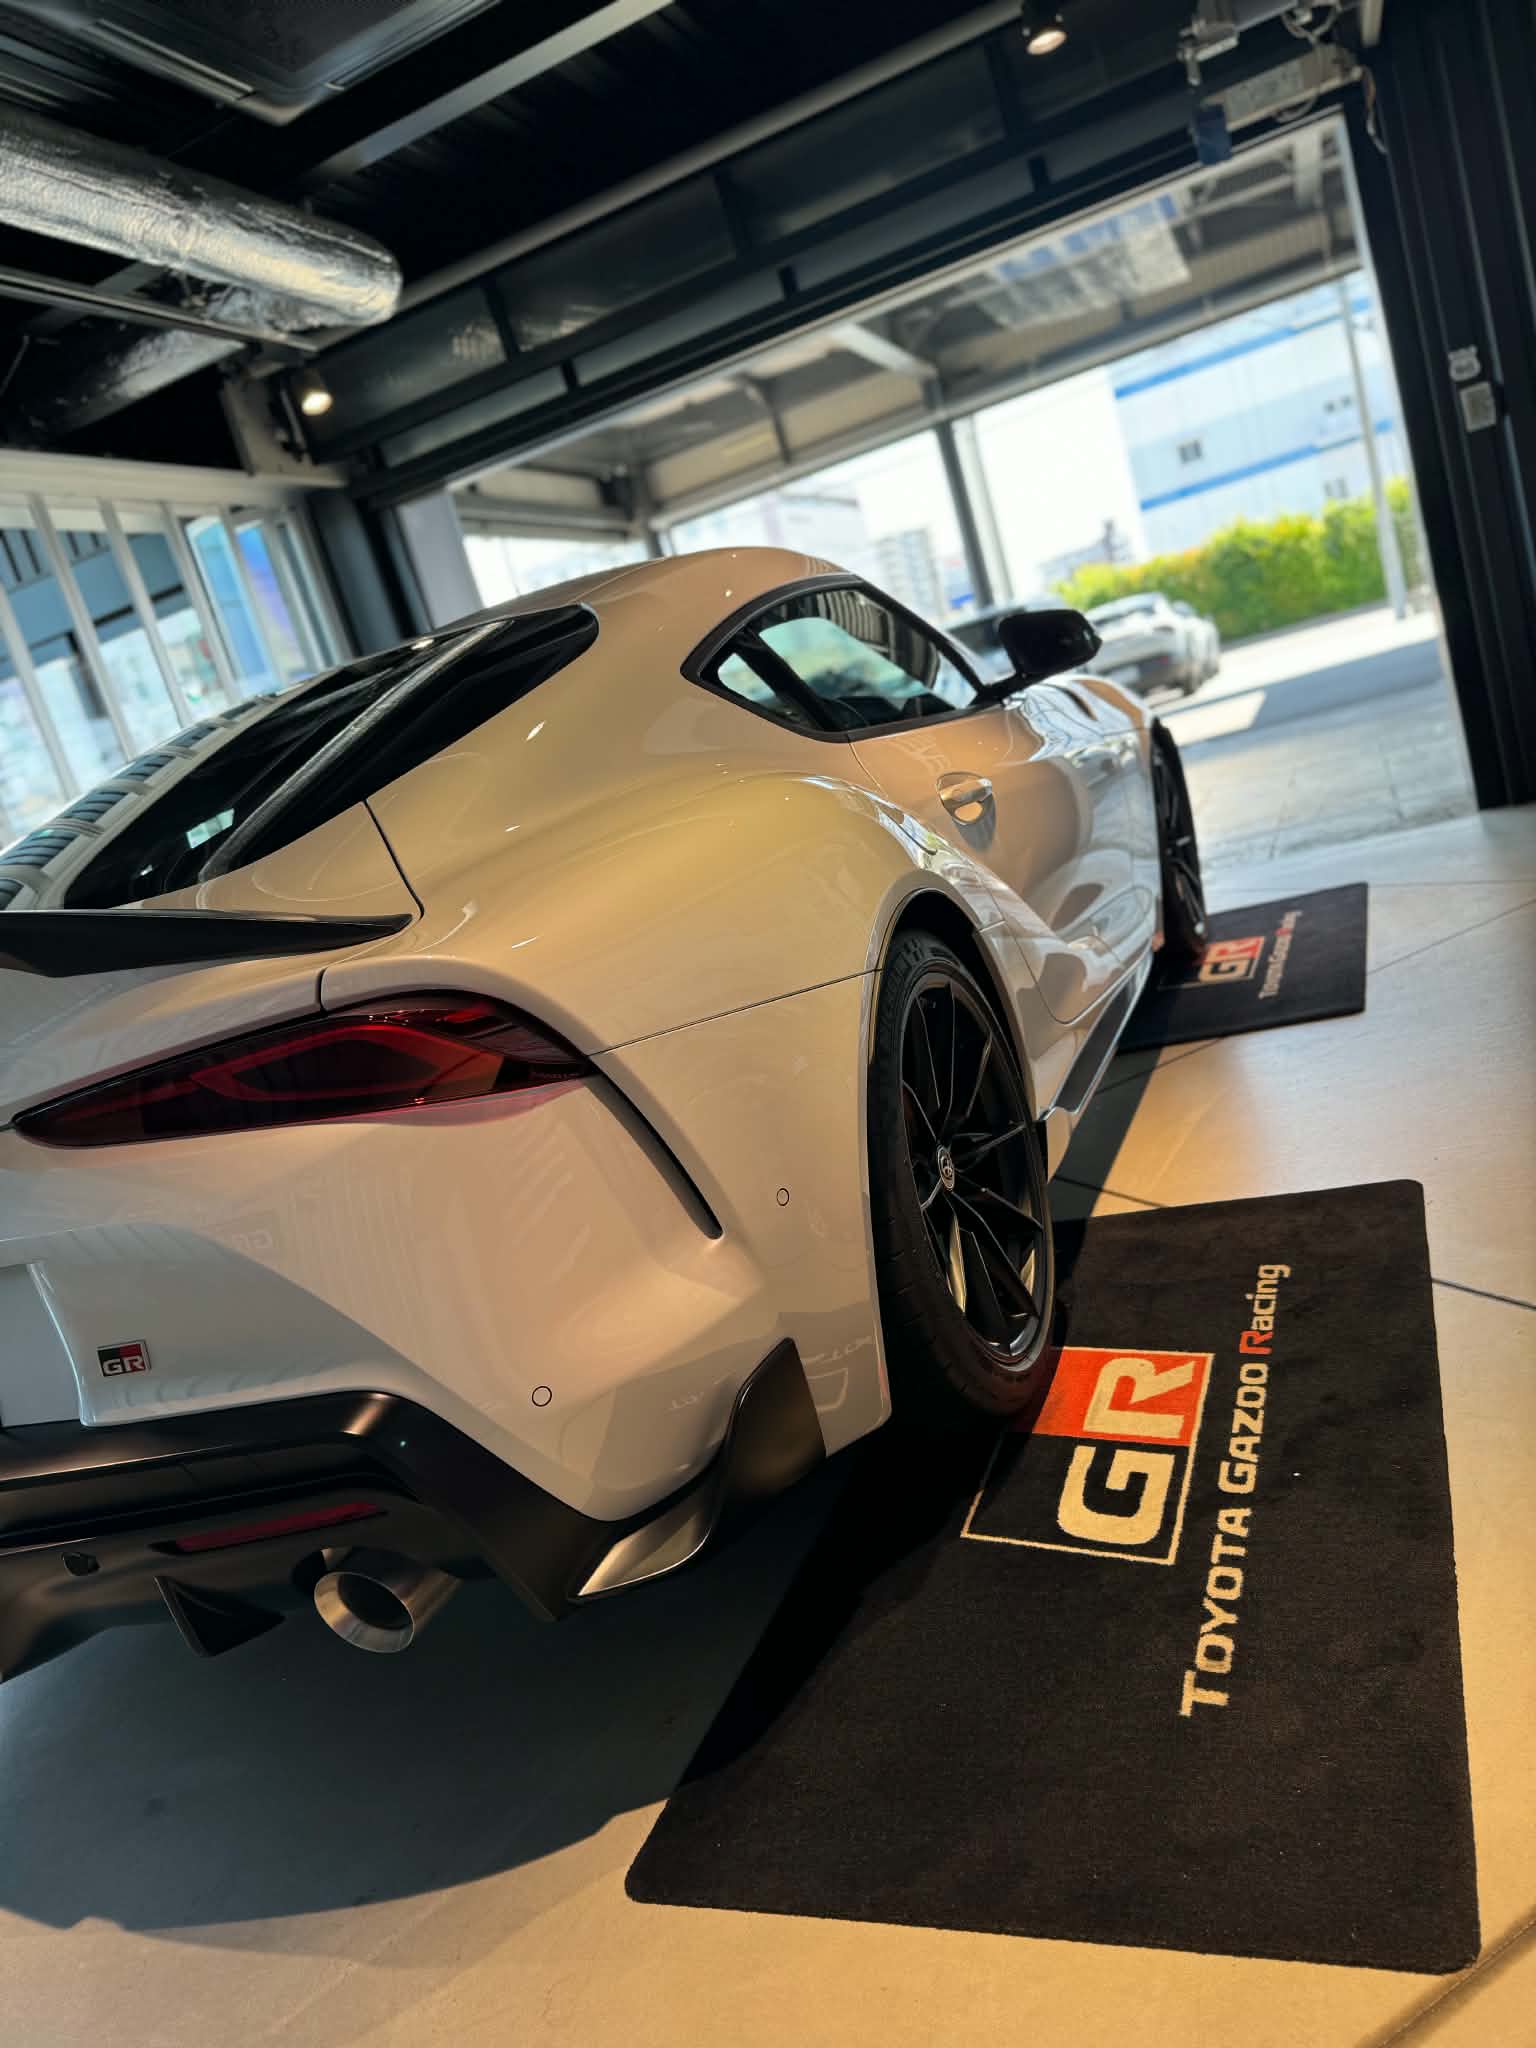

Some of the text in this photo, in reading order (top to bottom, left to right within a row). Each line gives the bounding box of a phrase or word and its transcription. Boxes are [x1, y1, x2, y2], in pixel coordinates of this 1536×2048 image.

[102, 1355, 145, 1375] GR
[1057, 1357, 1196, 1545] GR
[1179, 1263, 1292, 1718] TOYOTA GAZOO Racing
